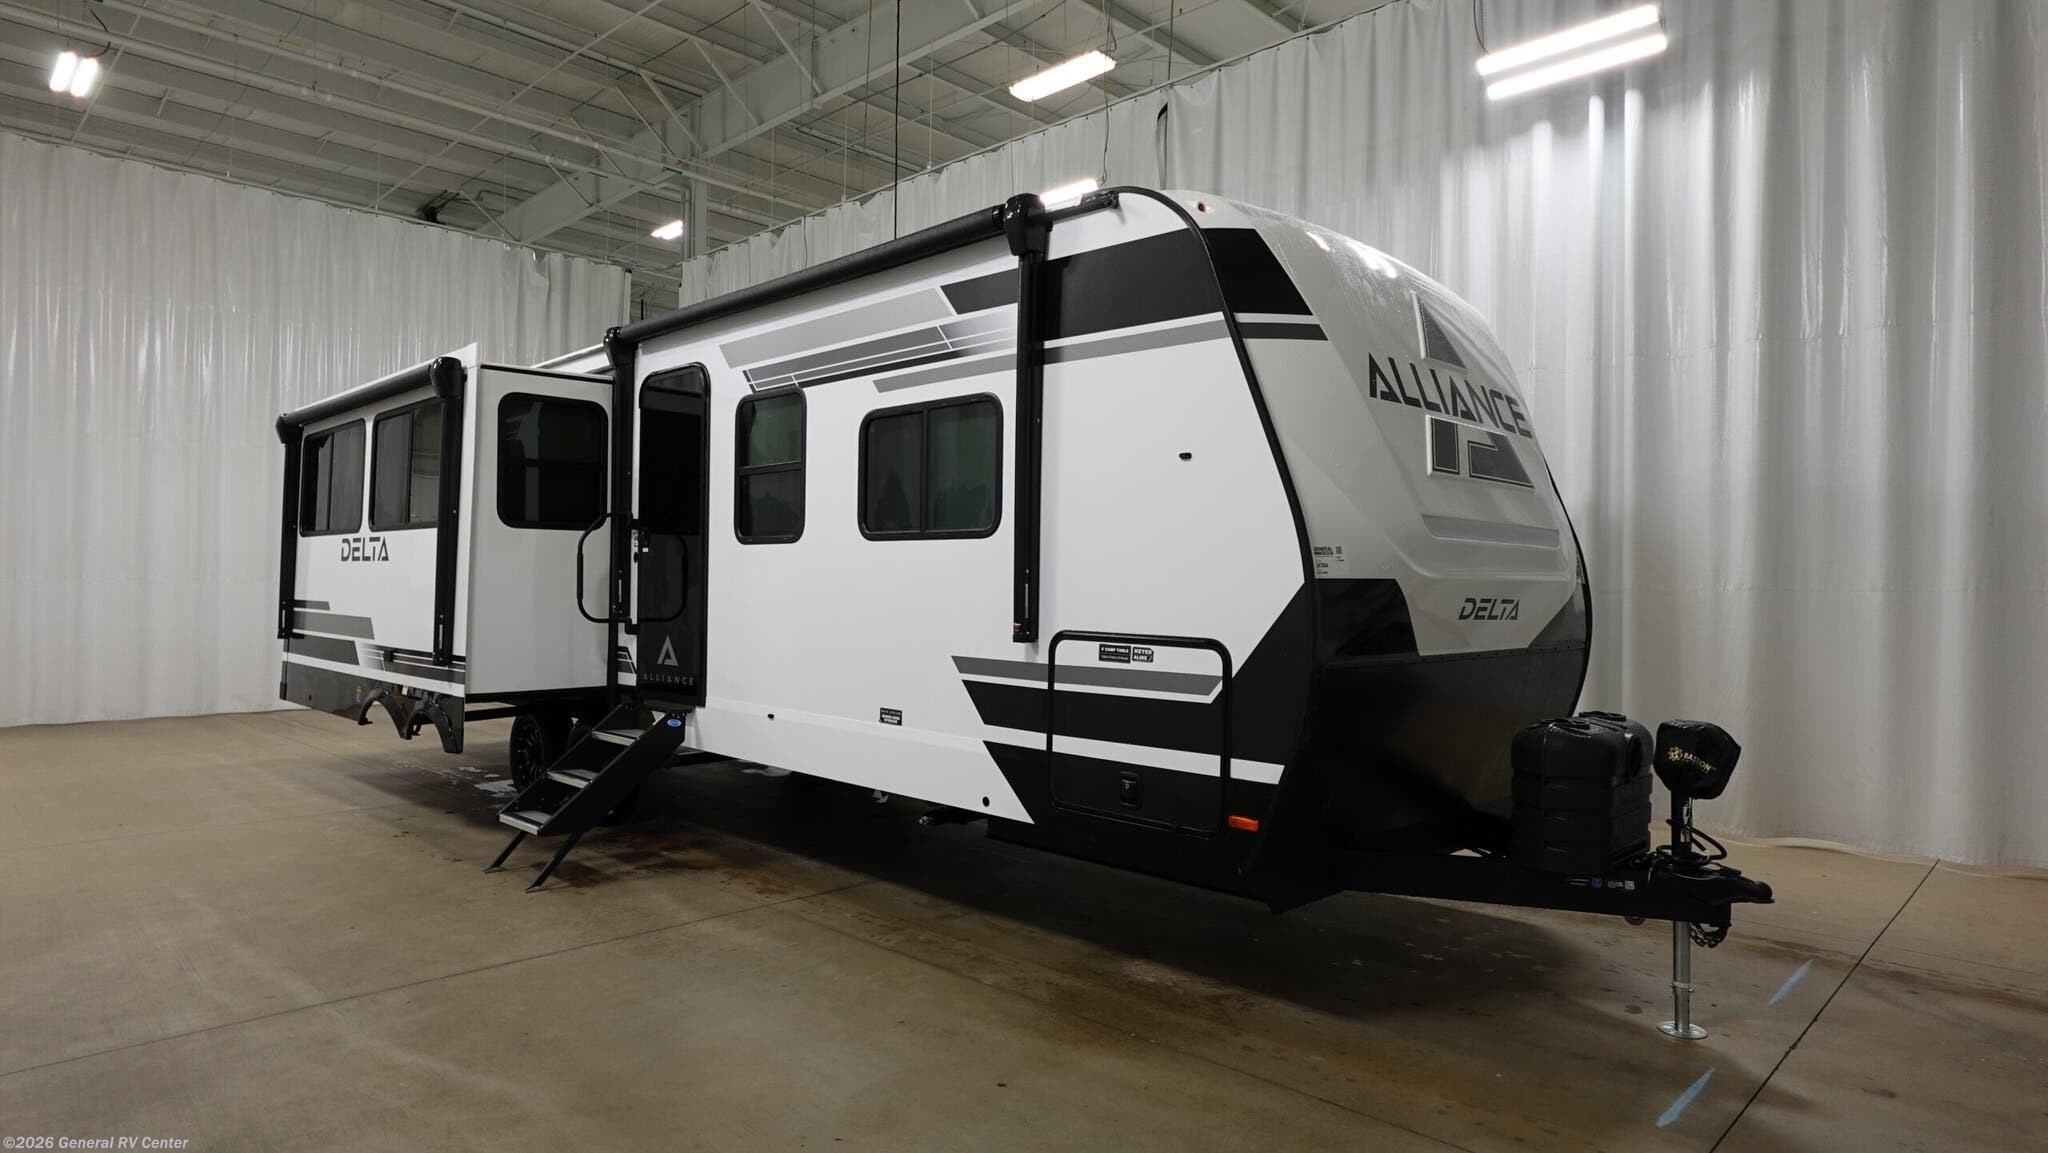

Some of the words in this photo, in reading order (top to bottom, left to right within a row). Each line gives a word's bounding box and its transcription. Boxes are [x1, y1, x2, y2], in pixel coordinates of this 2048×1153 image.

[1368, 352, 1533, 439] ALLIANCE
[341, 536, 389, 562] DELTA
[1458, 597, 1520, 620] DELTA
[643, 672, 695, 686] ALLIANCE
[1683, 752, 1712, 771] BASTION
